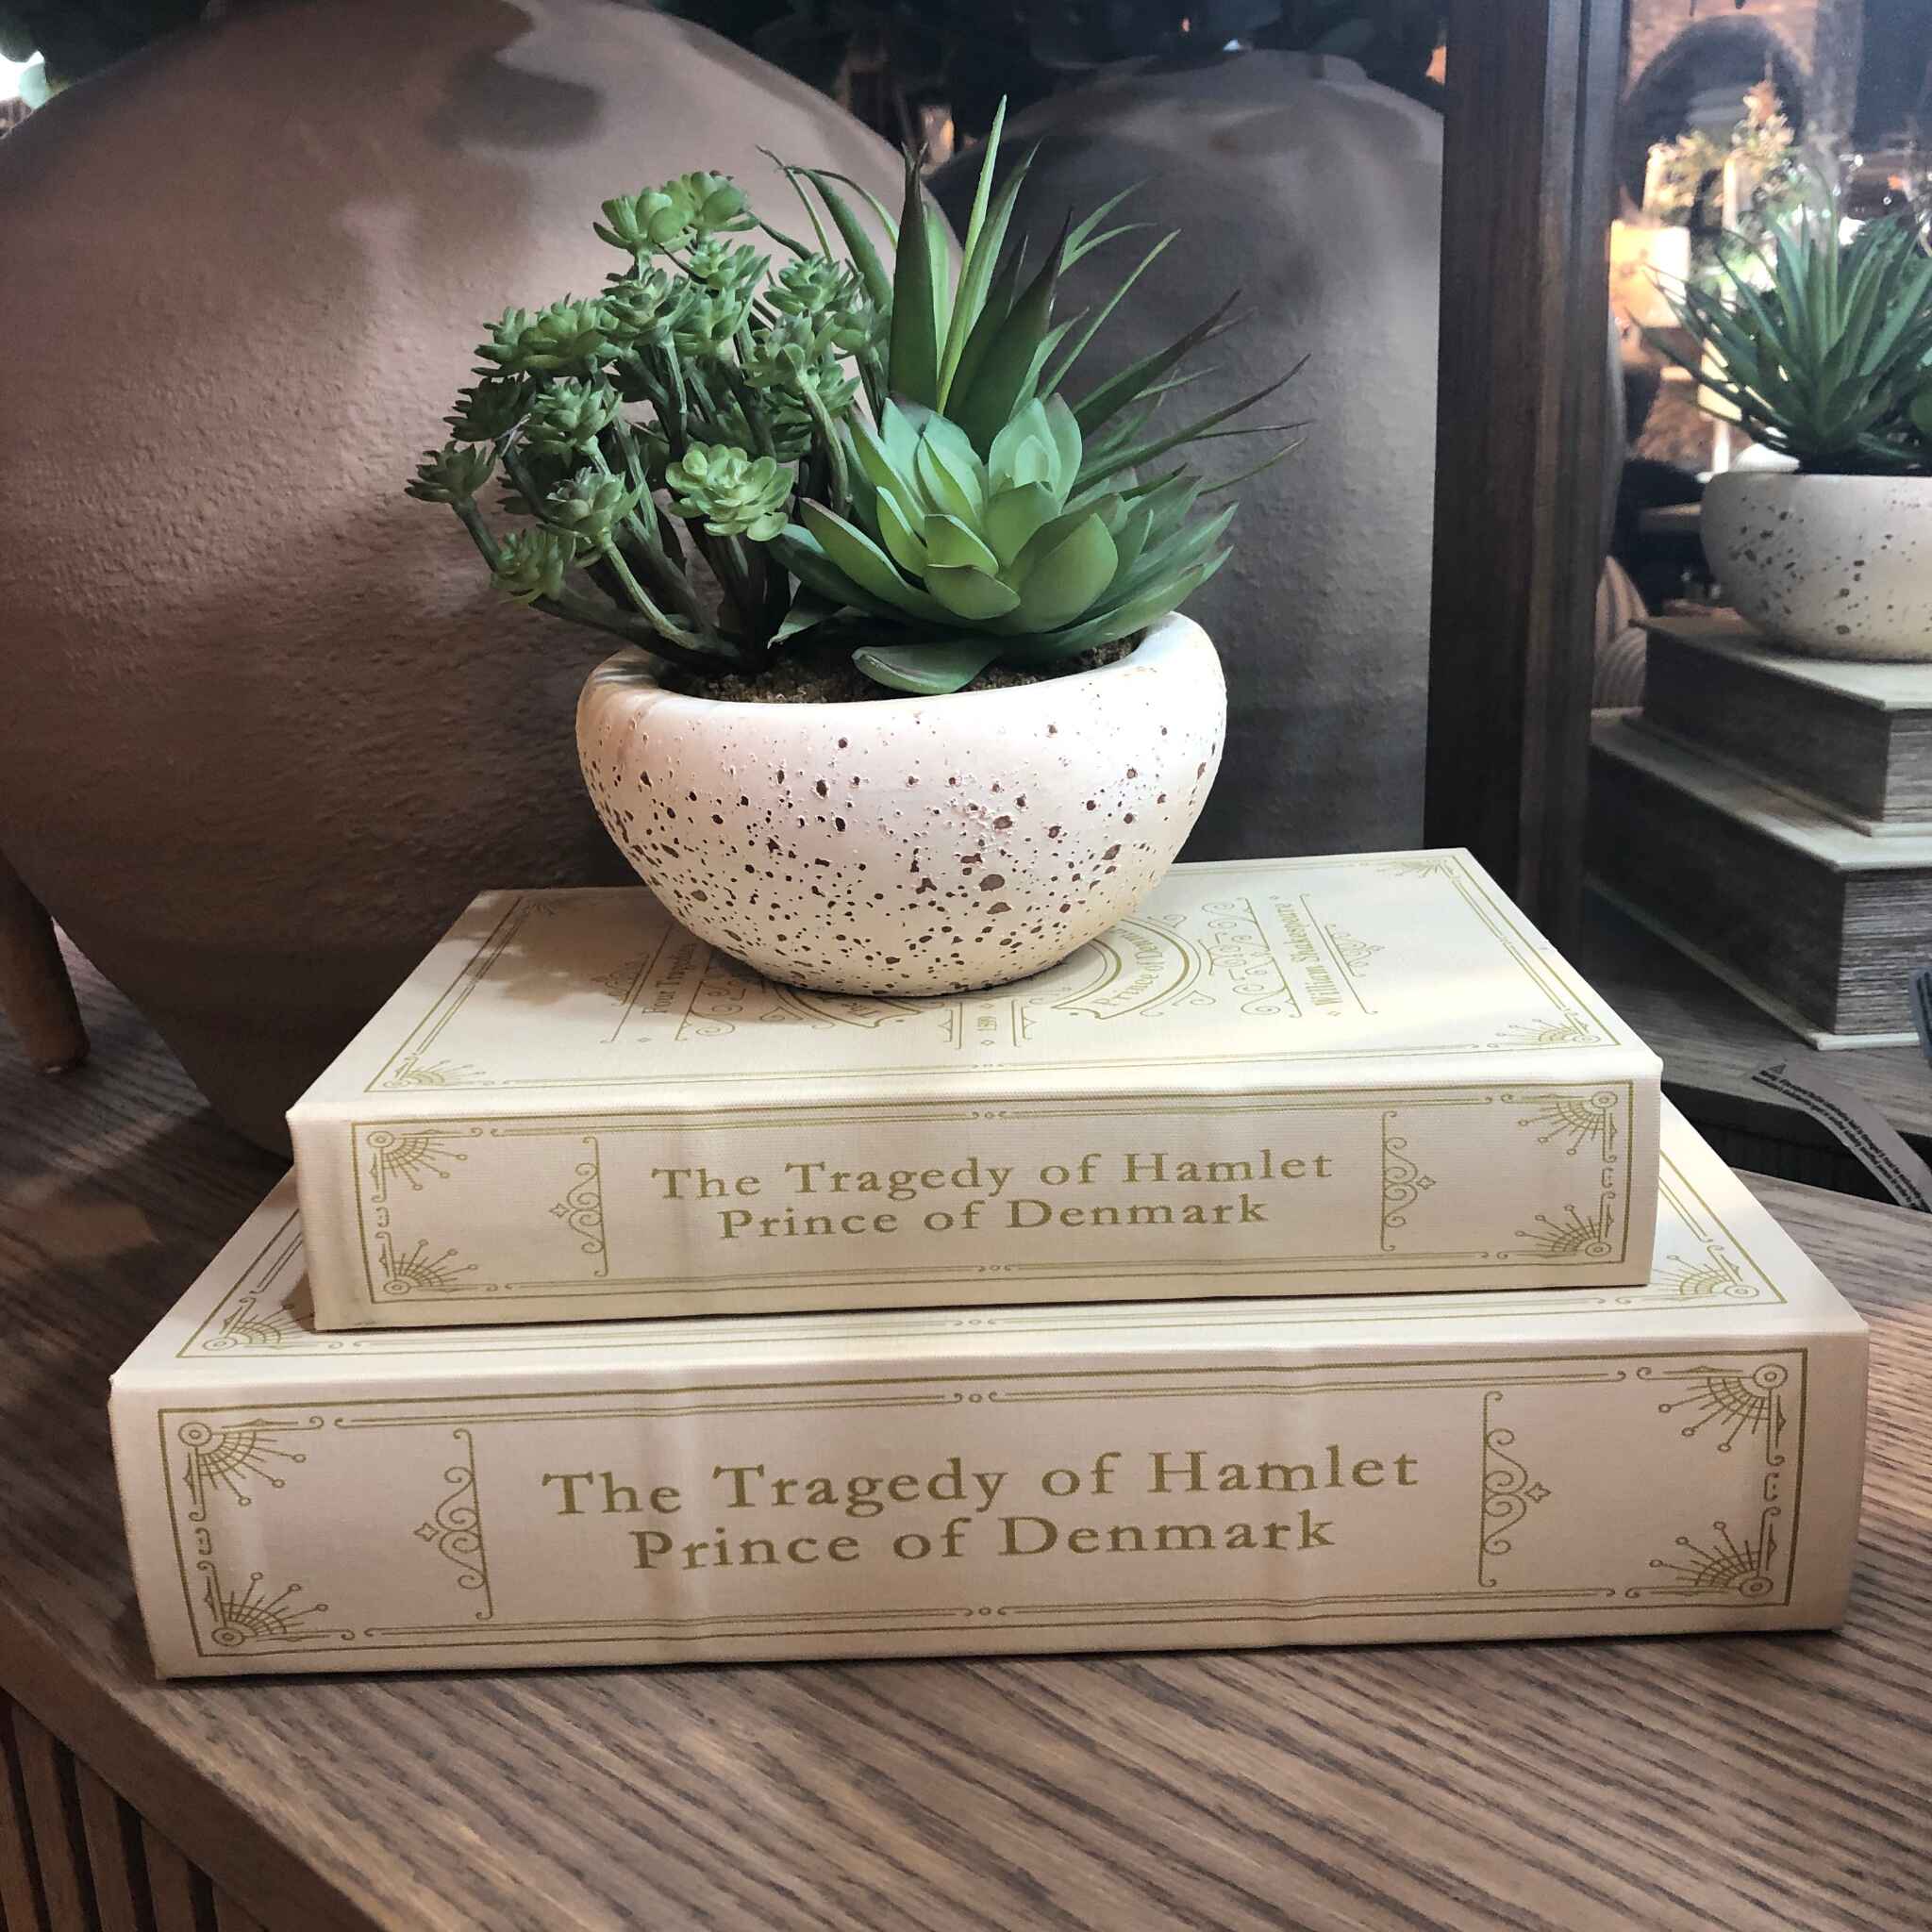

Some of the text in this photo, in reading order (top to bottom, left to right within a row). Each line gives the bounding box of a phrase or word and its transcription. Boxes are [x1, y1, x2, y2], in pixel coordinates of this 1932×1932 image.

[1305, 964, 1343, 1007] William
[651, 1148, 1334, 1203] The Tragedy of Hamlet
[717, 1194, 1269, 1241] Prince of Denmark
[541, 1443, 1420, 1519] The Tragedy of Hamlet
[627, 1508, 1336, 1570] Prince of Denmark
